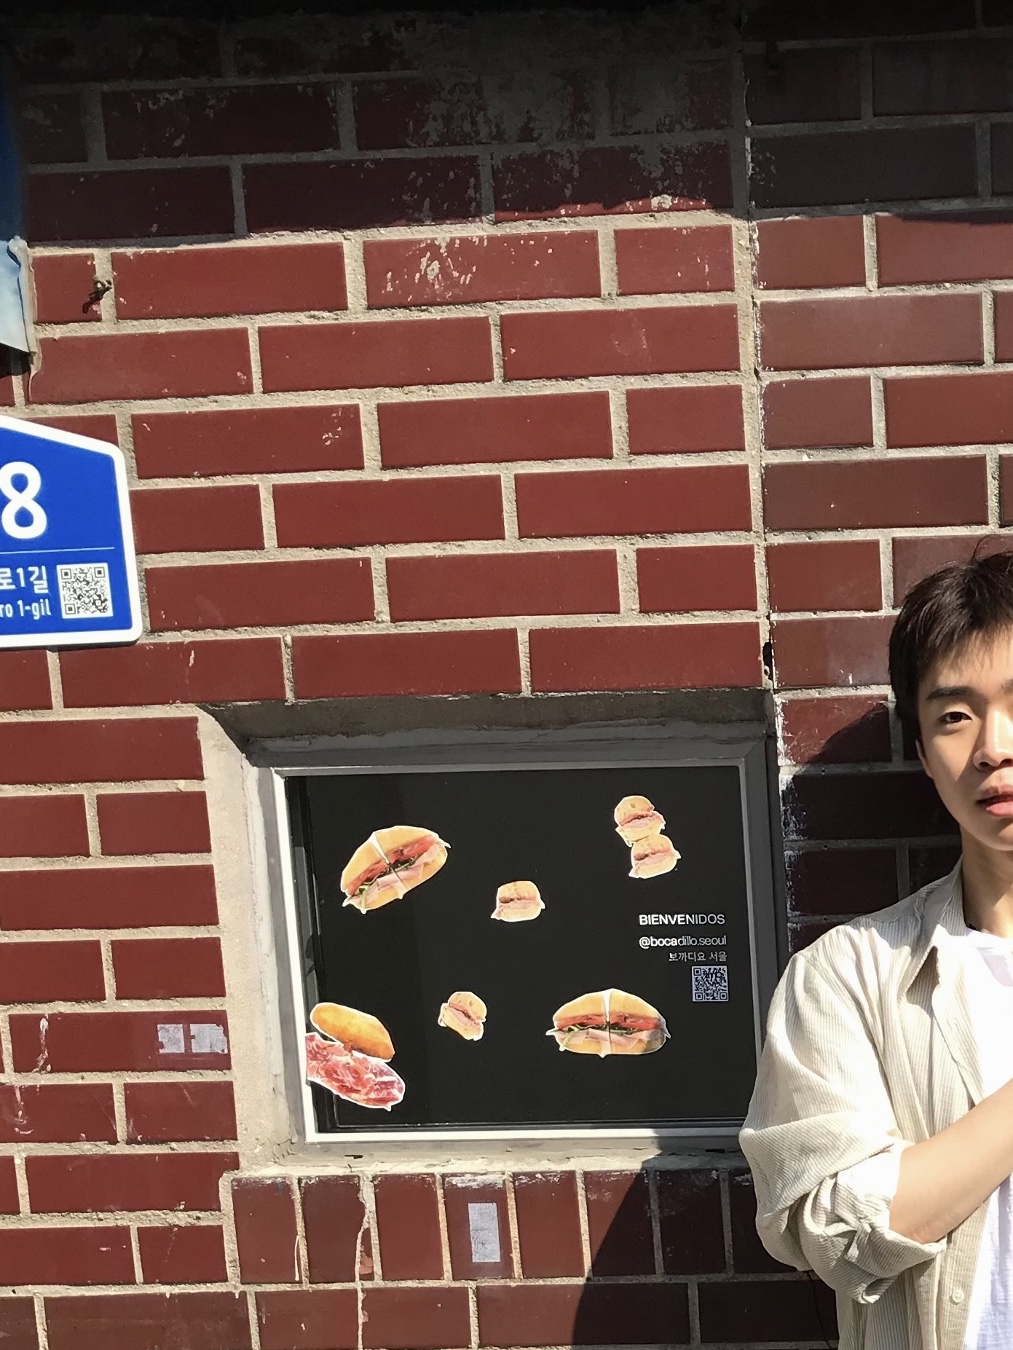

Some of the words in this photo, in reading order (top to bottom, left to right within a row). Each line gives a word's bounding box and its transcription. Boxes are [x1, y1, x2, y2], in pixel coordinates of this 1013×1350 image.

[0, 461, 47, 540] 8
[0, 565, 49, 594] 로1길
[17, 598, 52, 620] 1-gil
[638, 913, 726, 926] BIENVENIDOS
[638, 935, 727, 949] @bocadillo.seoul
[668, 951, 707, 962] 보까디요
[709, 951, 728, 962] 서울
